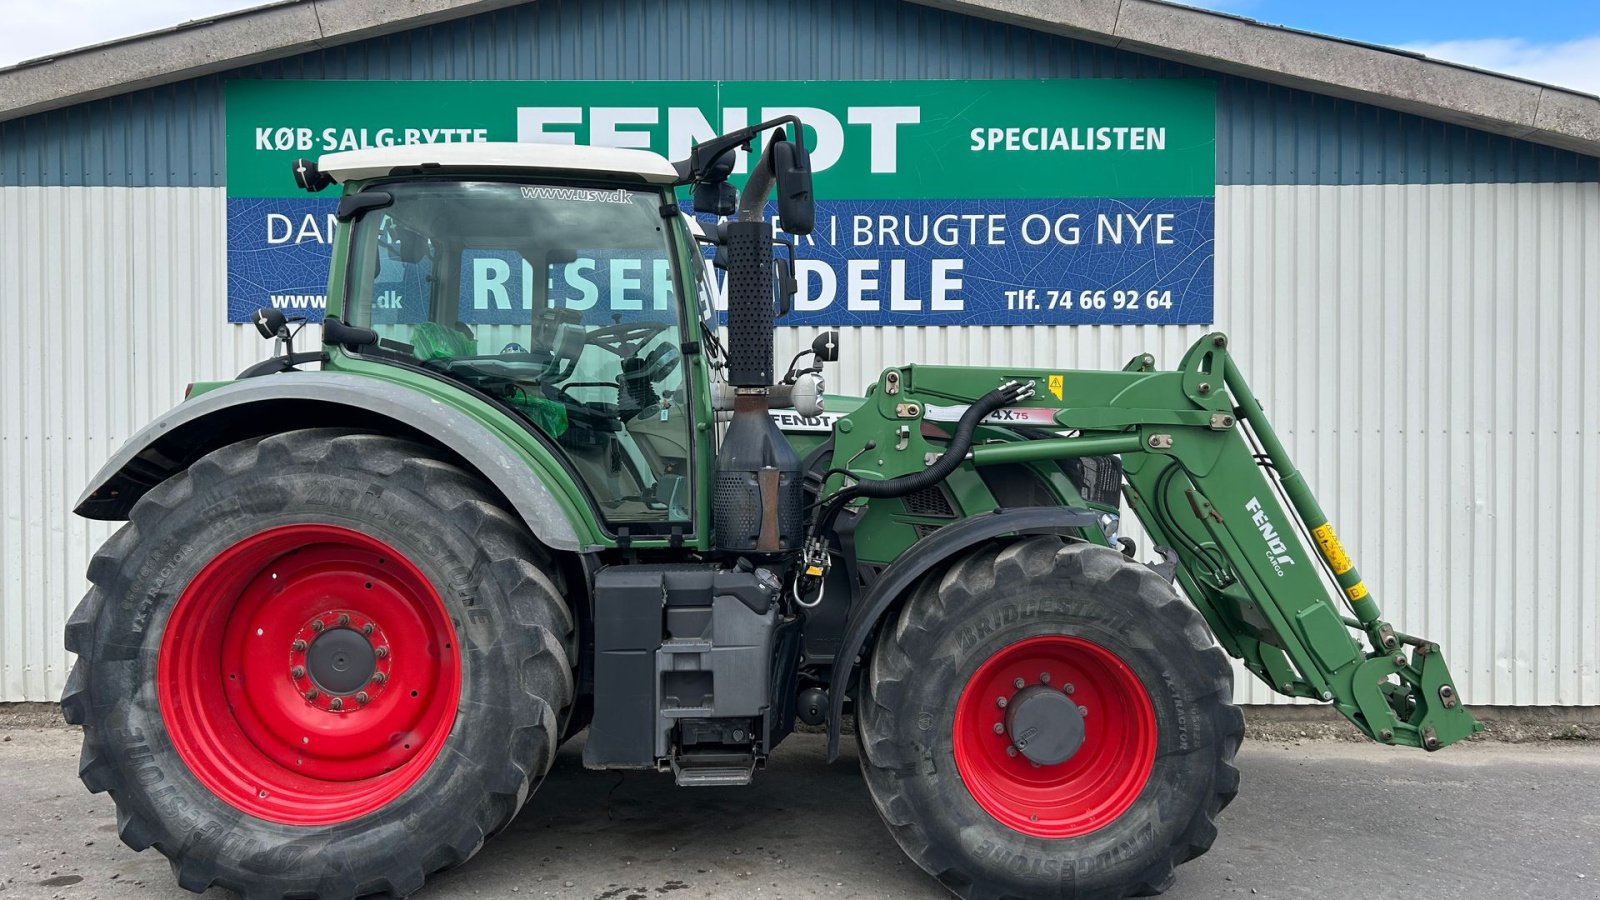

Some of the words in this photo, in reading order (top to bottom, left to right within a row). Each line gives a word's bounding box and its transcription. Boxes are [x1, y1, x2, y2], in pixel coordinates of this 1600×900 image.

[517, 107, 921, 174] FENDT
[970, 127, 1166, 151] SPECIALISTEN
[521, 187, 634, 205] www.usv.dk
[853, 215, 1006, 246] BRUGTE
[1021, 213, 1081, 246] OG
[1097, 213, 1174, 245] NYE
[1005, 289, 1040, 310] Tlf.
[1047, 290, 1073, 310] 74
[1079, 290, 1107, 310] 66
[1112, 290, 1139, 310] 92
[1146, 290, 1173, 310] 64
[1245, 496, 1295, 566] FENDT
[1265, 550, 1284, 577] CARGO
